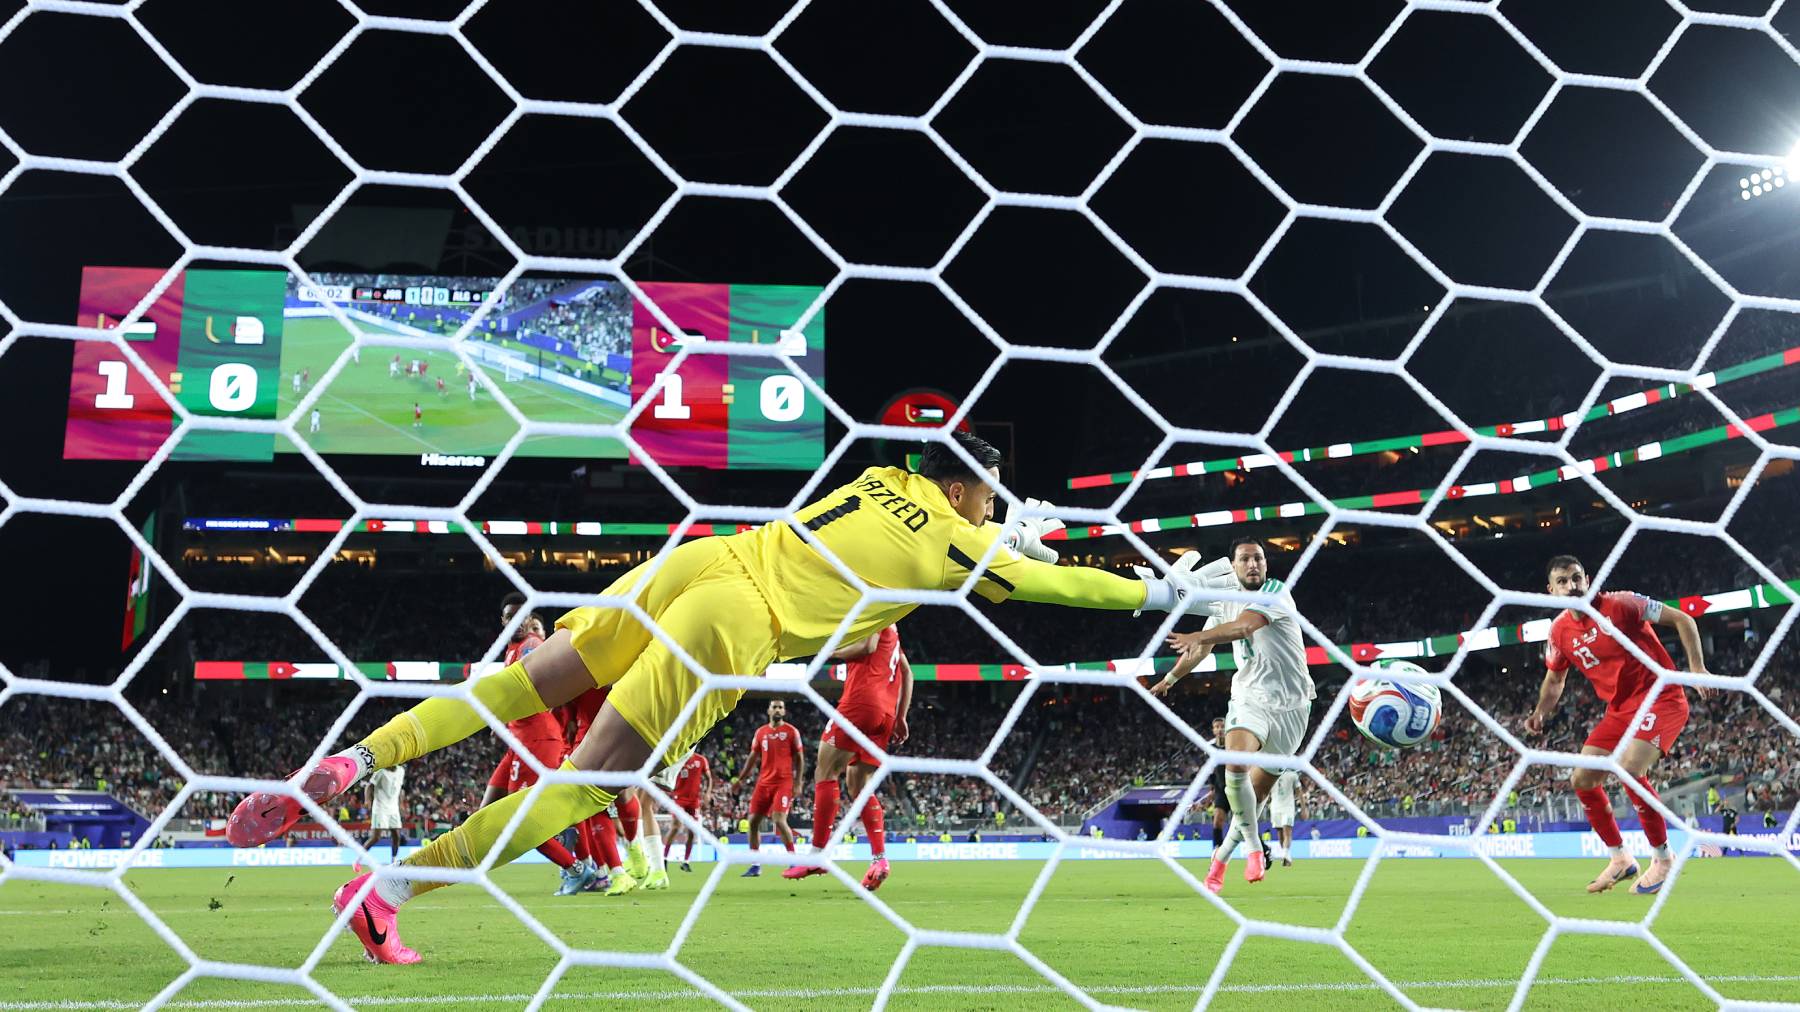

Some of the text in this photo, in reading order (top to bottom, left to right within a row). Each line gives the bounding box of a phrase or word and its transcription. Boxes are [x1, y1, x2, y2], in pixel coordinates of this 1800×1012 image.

[464, 224, 638, 251] SADIUM
[95, 361, 134, 409] 1
[209, 363, 258, 412] 0
[655, 373, 690, 419] 1
[760, 375, 805, 422] 0
[421, 453, 486, 467] Hisense
[788, 494, 862, 544] 1
[51, 849, 164, 867] POWERDE
[232, 848, 342, 865] POWERADE
[917, 843, 1018, 859] POWERADE
